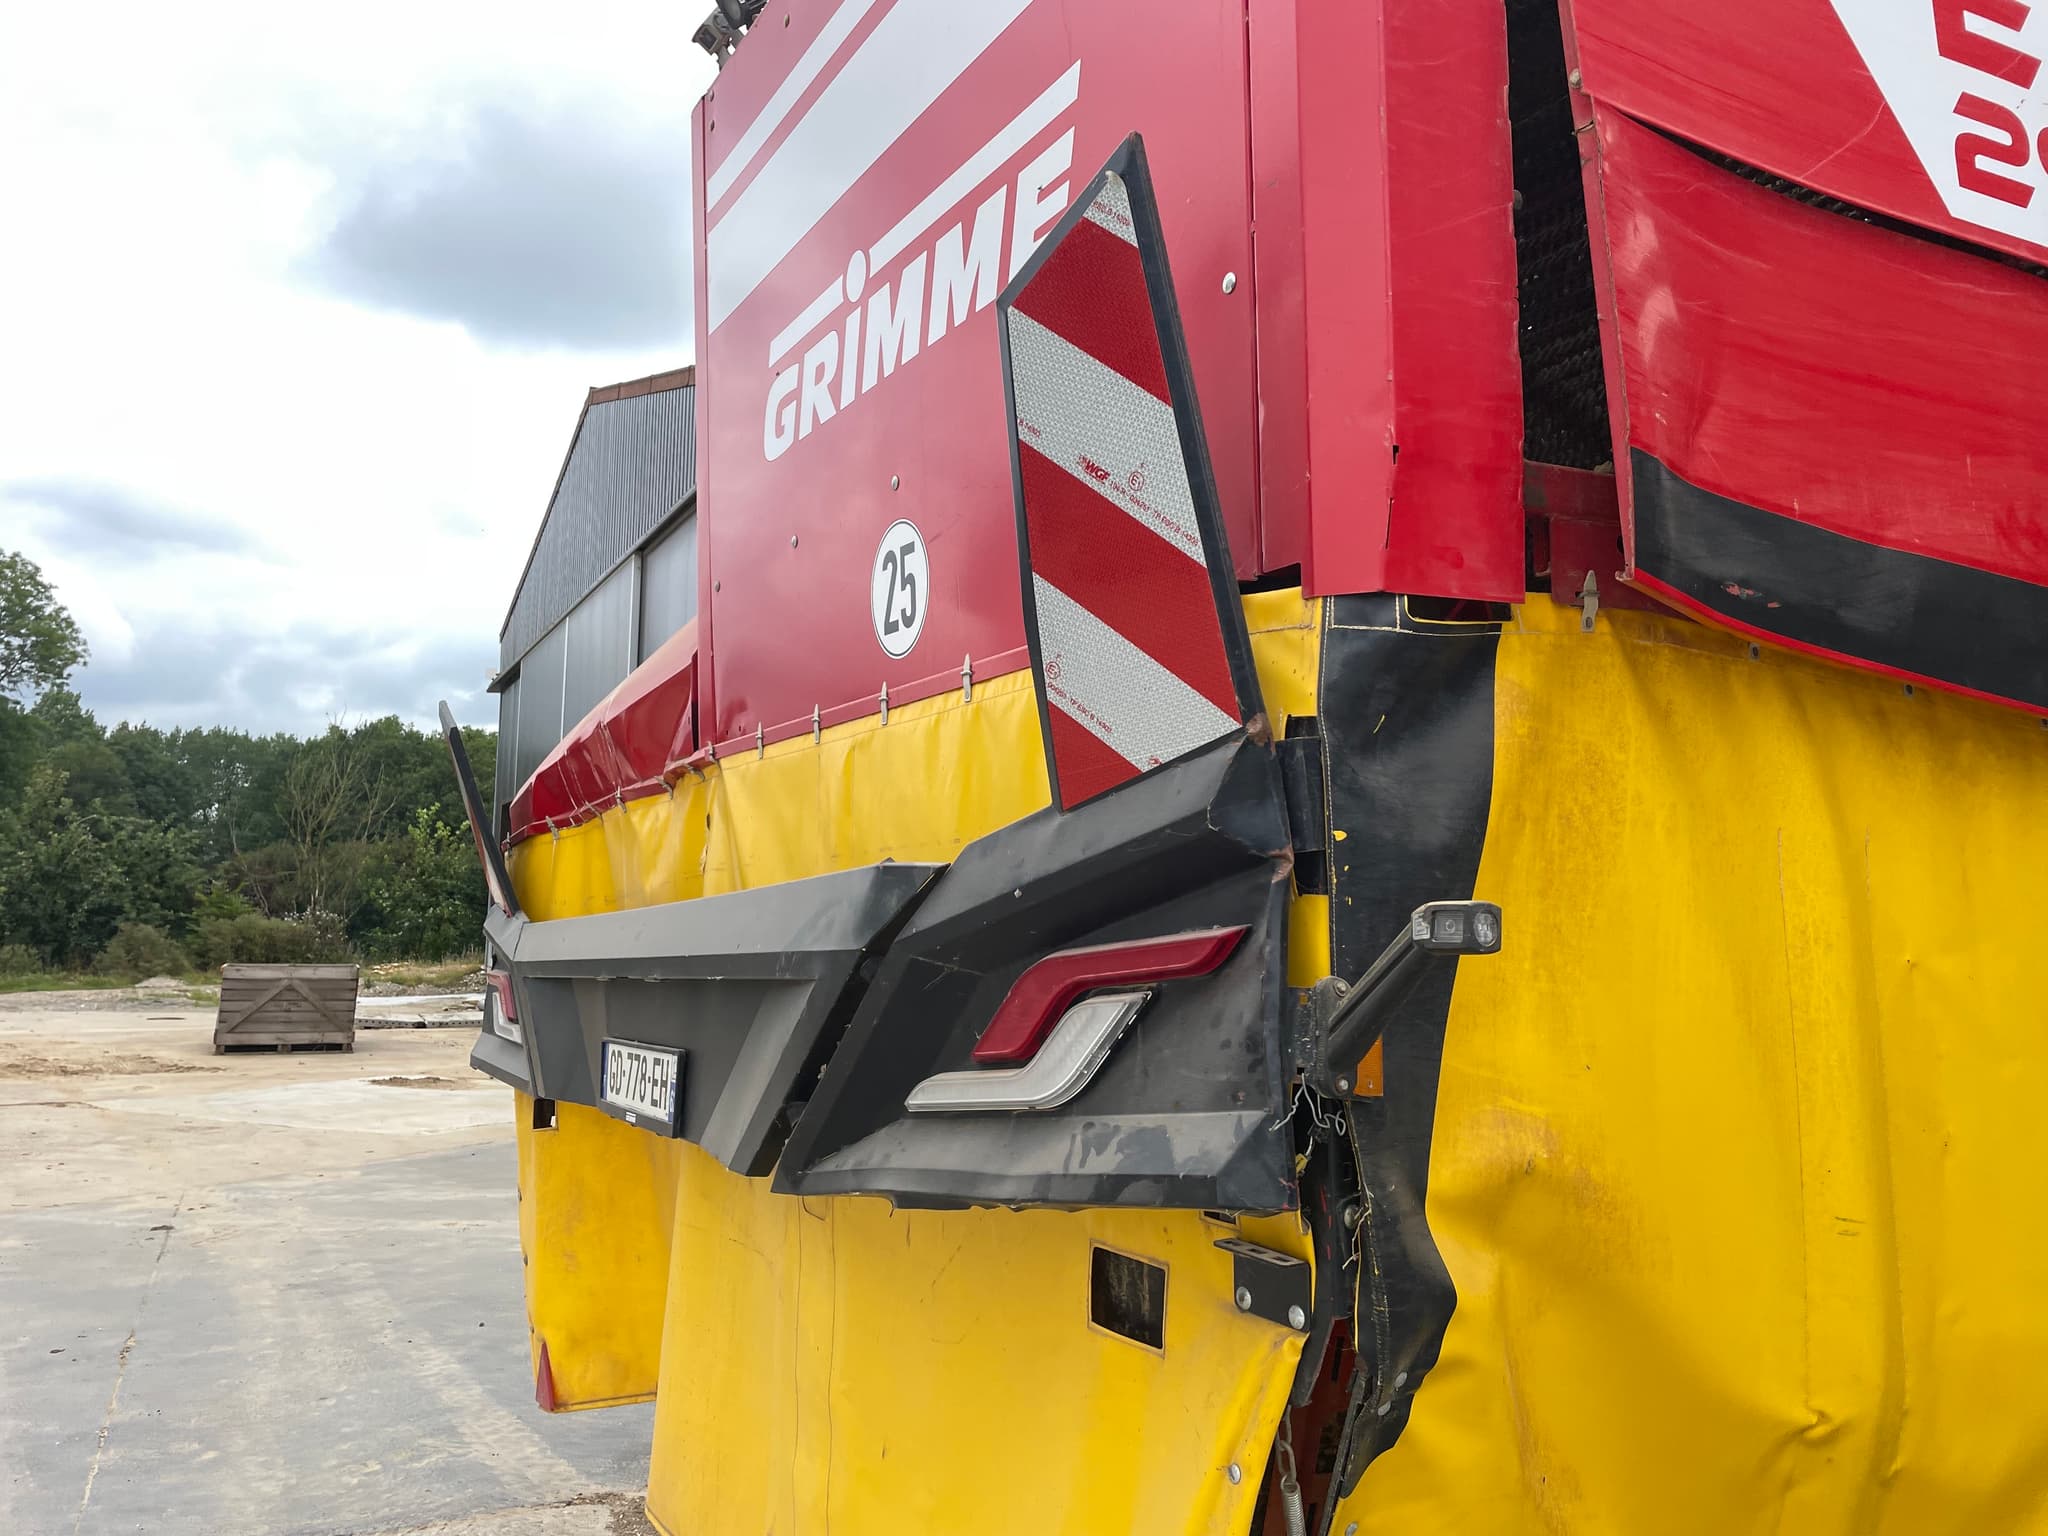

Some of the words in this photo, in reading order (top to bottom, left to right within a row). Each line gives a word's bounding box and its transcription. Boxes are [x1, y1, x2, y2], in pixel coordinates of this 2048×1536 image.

[1953, 91, 2048, 209] 2
[763, 125, 1076, 462] GRIMME
[1085, 459, 1111, 481] WGF
[882, 540, 917, 636] 25
[609, 1048, 670, 1111] GD-778-EH
